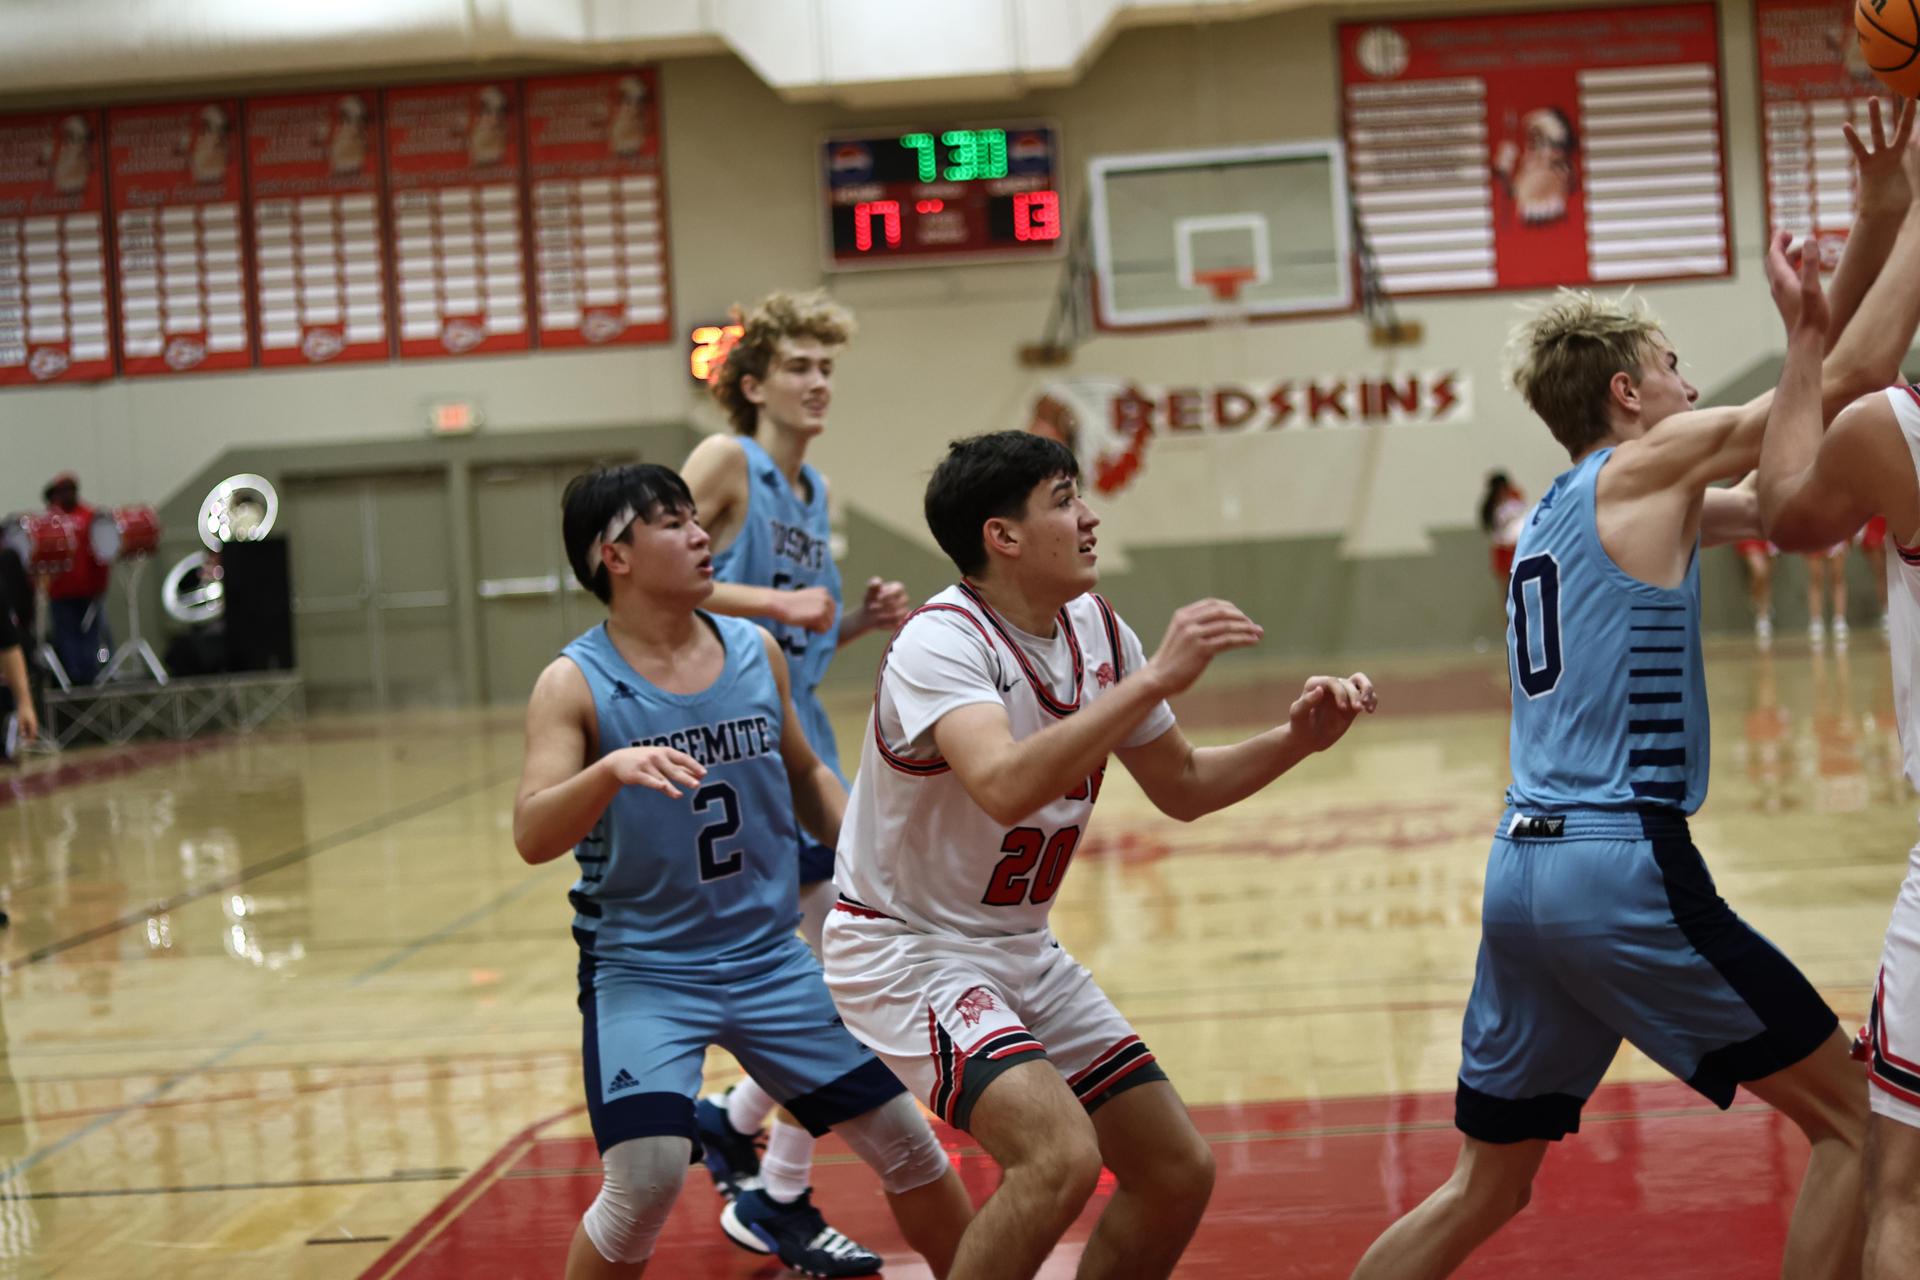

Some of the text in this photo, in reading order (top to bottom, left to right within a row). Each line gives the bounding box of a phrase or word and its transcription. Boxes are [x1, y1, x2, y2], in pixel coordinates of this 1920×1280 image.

[1112, 374, 1459, 437] REDSKINS
[631, 716, 771, 766] SEMITE
[692, 781, 743, 883] 2
[980, 825, 1081, 907] 20
